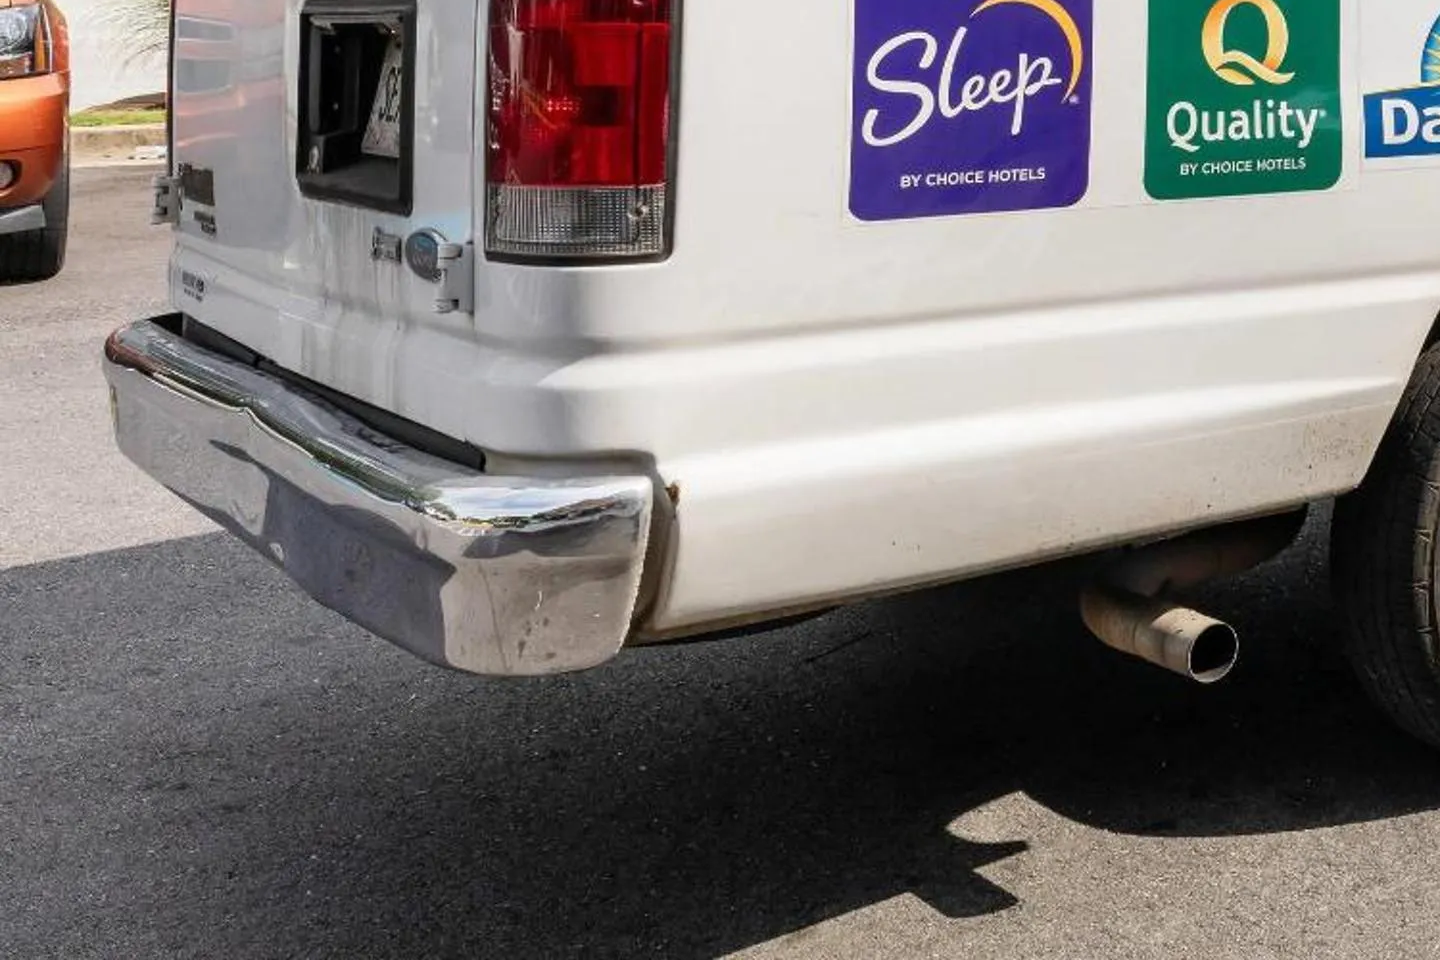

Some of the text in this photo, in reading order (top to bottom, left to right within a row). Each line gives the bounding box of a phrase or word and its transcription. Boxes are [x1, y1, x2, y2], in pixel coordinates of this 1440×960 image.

[861, 26, 1062, 147] Sleep
[1166, 99, 1319, 153] Quality
[900, 166, 1046, 189] BY CHOICE HOTELS
[1180, 157, 1306, 176] BY CHOICE HOTELS
